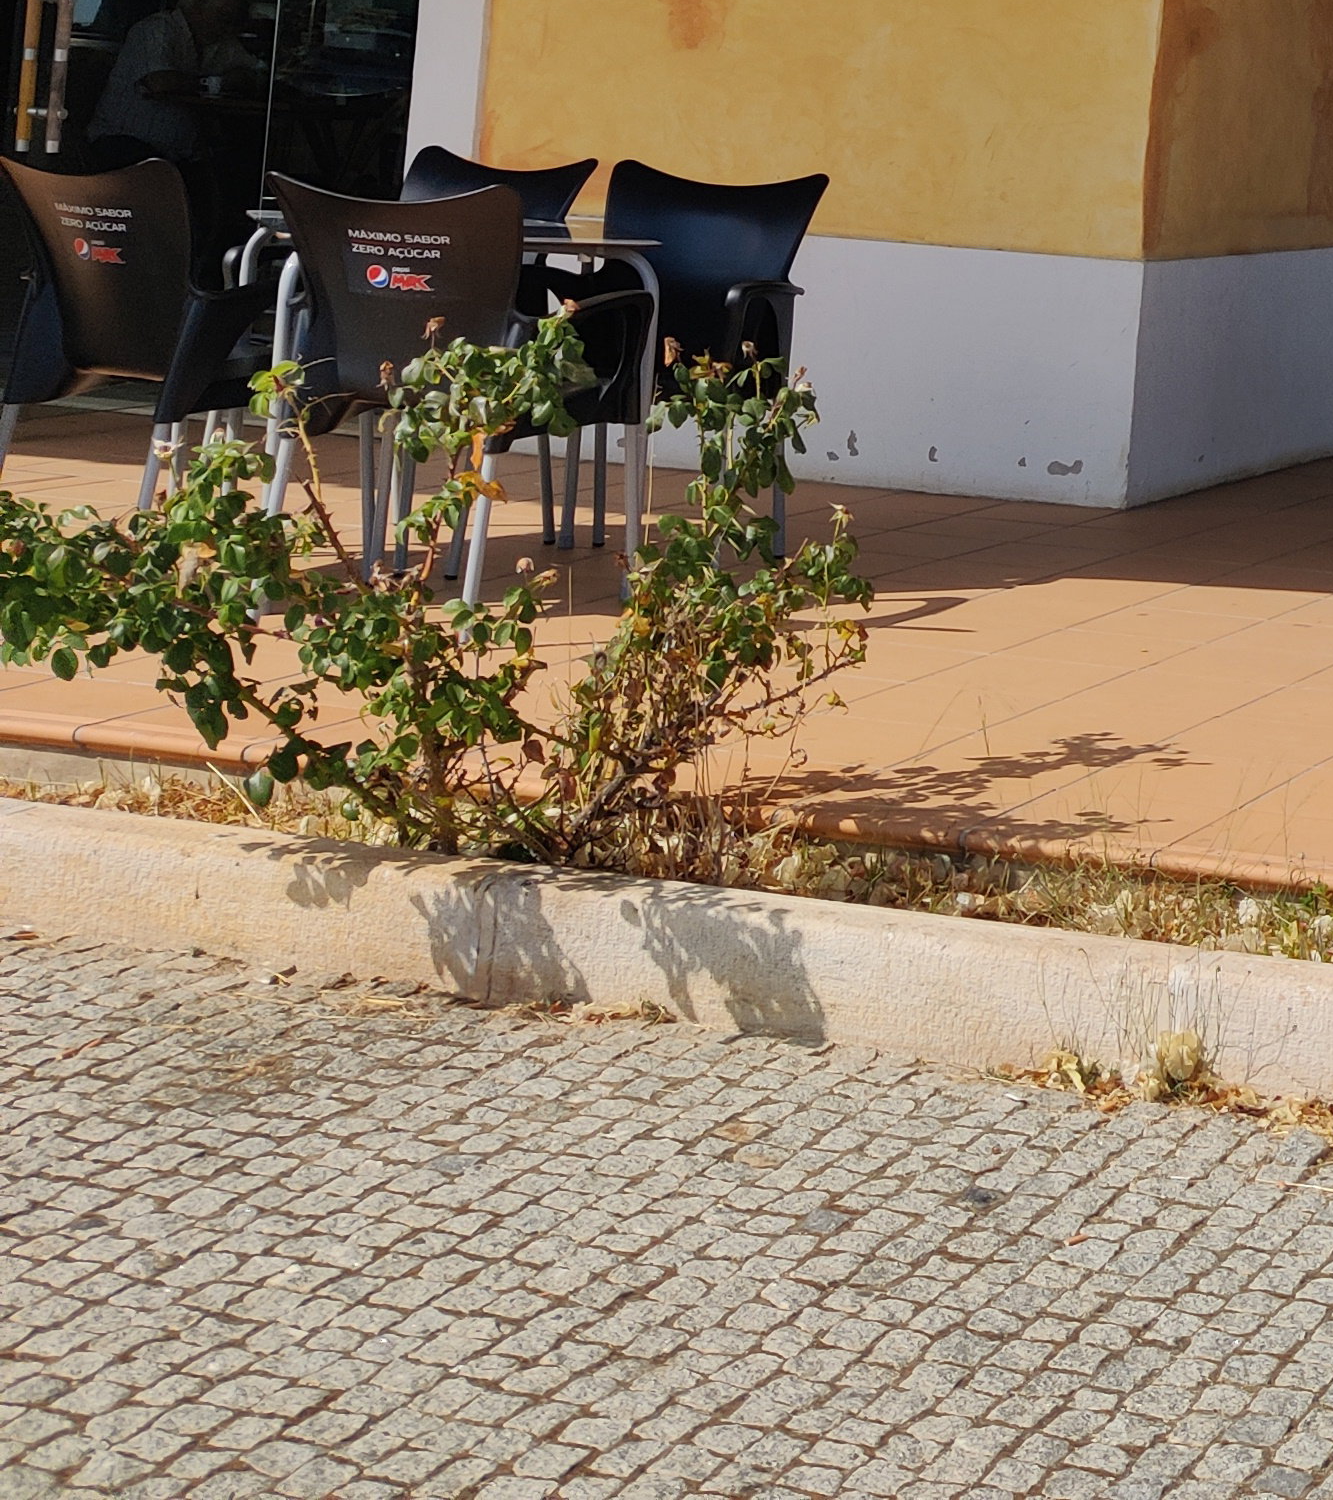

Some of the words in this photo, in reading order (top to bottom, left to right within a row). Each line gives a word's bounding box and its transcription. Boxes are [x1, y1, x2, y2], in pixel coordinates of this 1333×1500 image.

[95, 207, 133, 218] SABOR
[61, 216, 84, 228] ZERO
[85, 220, 127, 232] AÇÚCAR
[348, 228, 401, 243] MÁXIMO
[404, 234, 450, 245] SABOR
[351, 243, 384, 255] ZERO
[388, 247, 441, 259] AÇÚCAR
